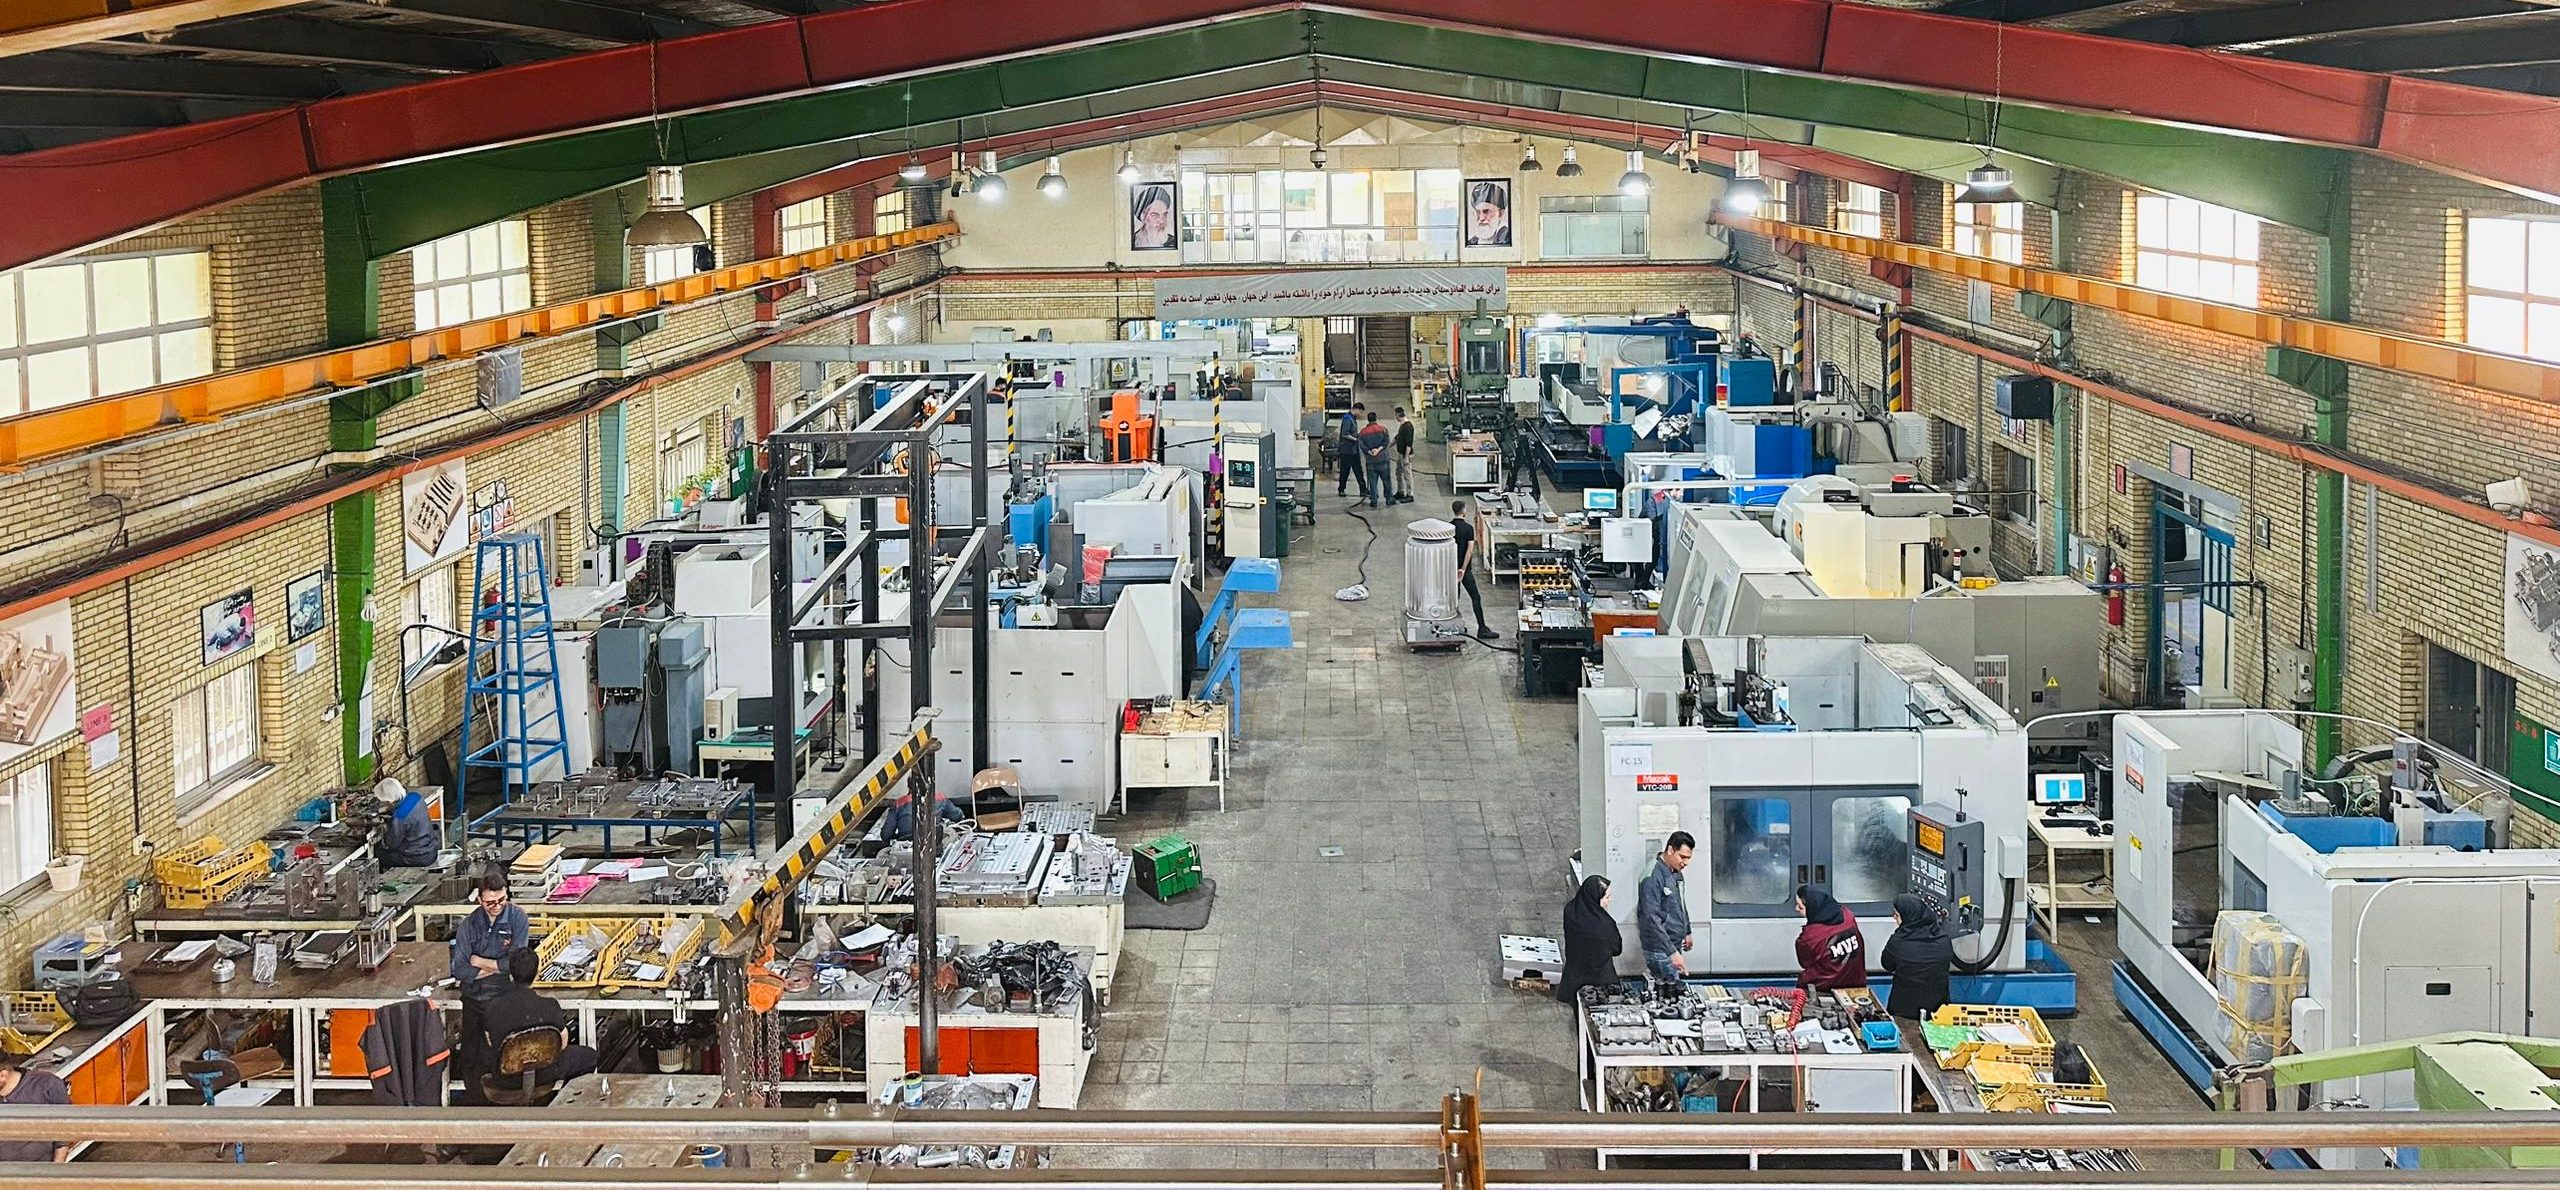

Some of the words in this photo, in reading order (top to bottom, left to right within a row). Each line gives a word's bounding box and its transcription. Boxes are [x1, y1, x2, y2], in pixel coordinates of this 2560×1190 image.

[1312, 289, 1318, 300] را
[1319, 288, 1331, 299] خود
[1346, 287, 1364, 298] ساحل
[1486, 283, 1500, 295] برای
[1188, 292, 1202, 303] است
[1222, 292, 1237, 304] جهان
[86, 715, 101, 731] LINE
[1830, 935, 1859, 958] MVS
